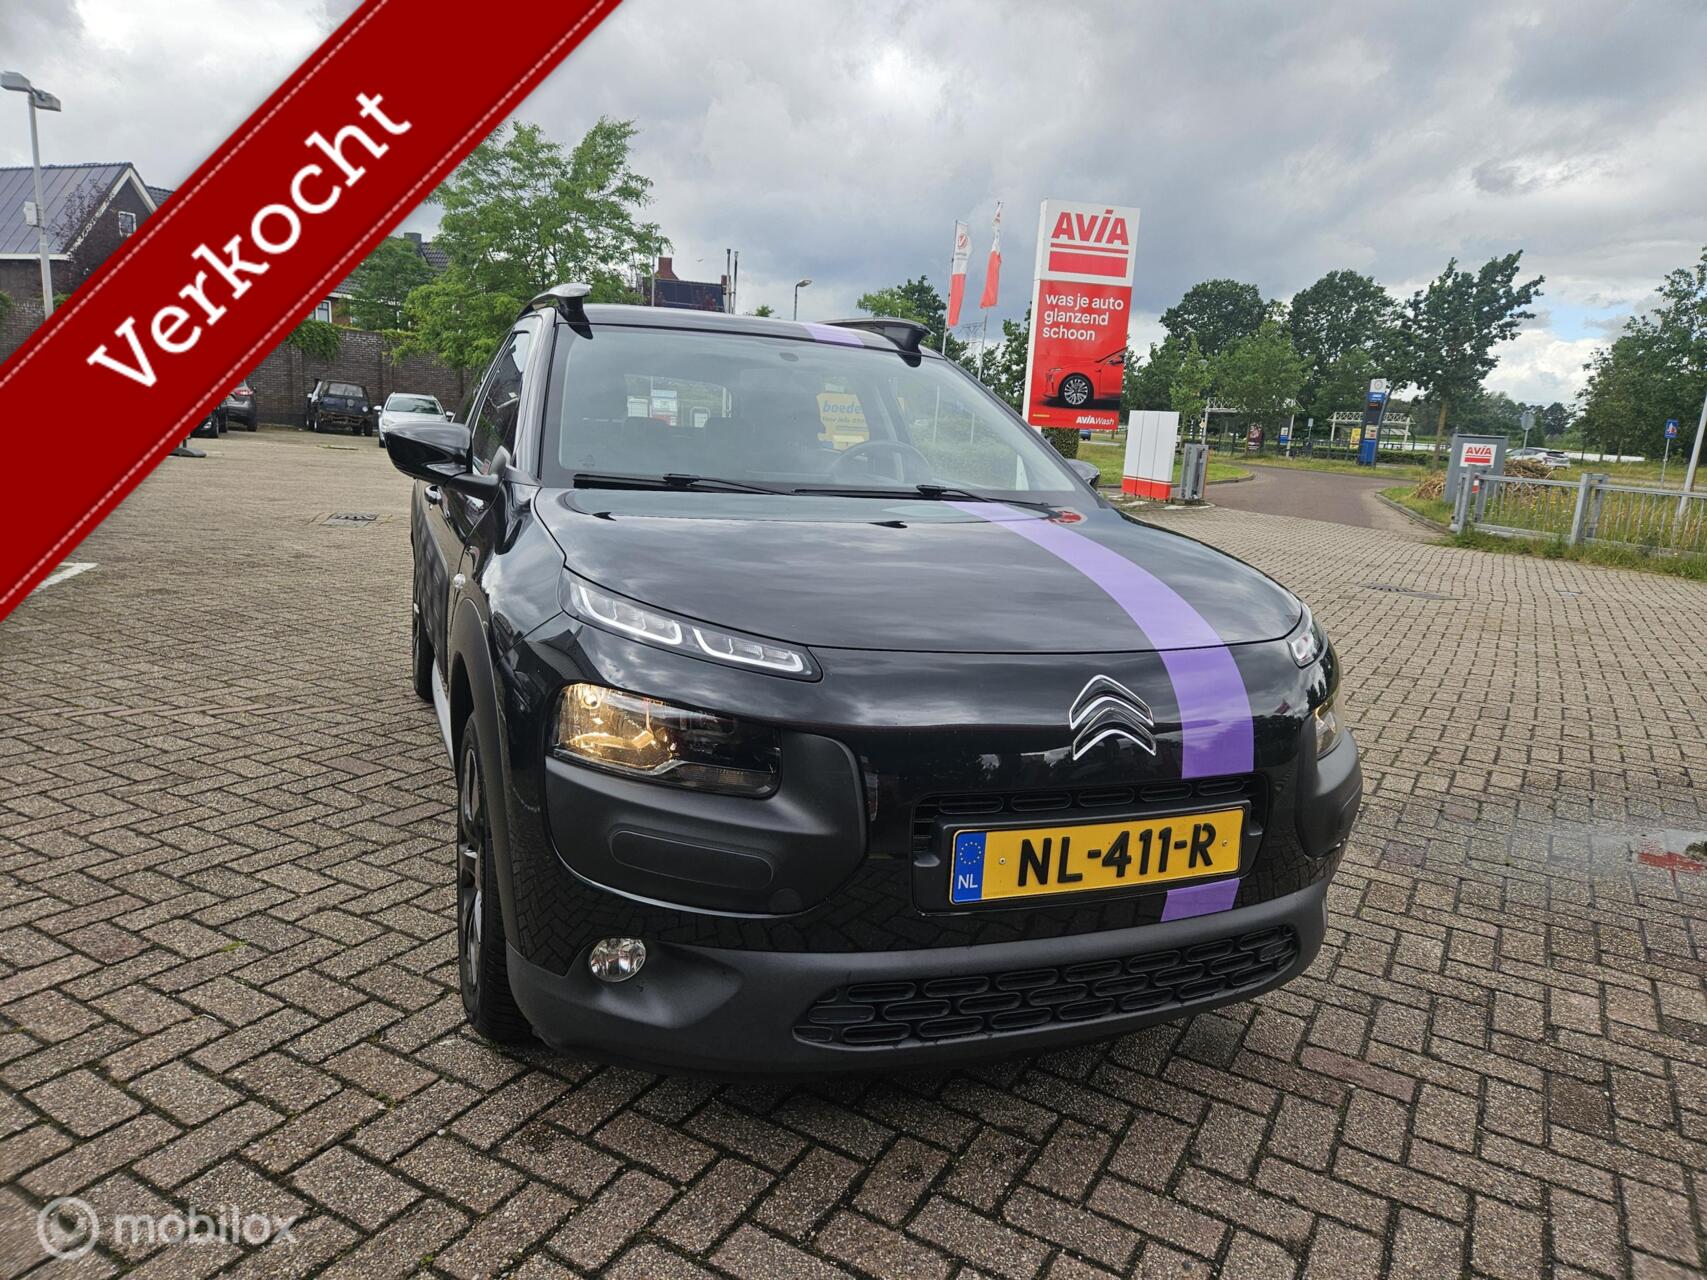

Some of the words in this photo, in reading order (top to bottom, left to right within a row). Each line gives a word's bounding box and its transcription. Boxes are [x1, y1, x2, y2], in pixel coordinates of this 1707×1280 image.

[1045, 293, 1074, 307] was
[1075, 293, 1090, 311] je
[1091, 296, 1124, 311] auto
[1043, 307, 1109, 326] glanzend
[1042, 325, 1096, 341] schoon
[1018, 823, 1216, 886] NL-411-R
[957, 874, 978, 890] NL
